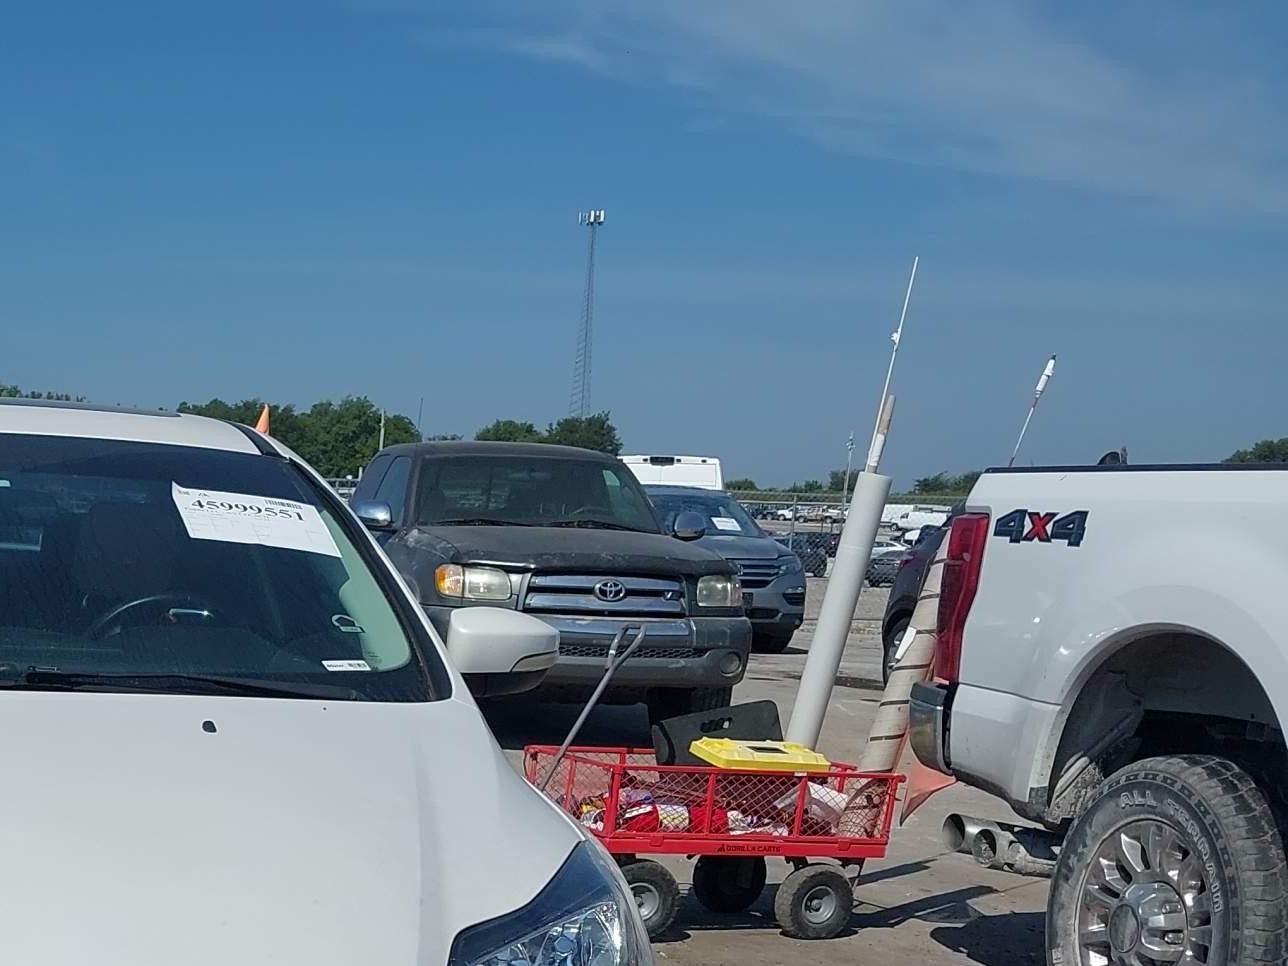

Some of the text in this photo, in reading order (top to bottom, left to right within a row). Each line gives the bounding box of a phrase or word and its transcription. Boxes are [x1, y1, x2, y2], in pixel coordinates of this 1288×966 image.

[191, 499, 306, 522] 45999551
[1120, 789, 1225, 913] ALL TERRAIN
